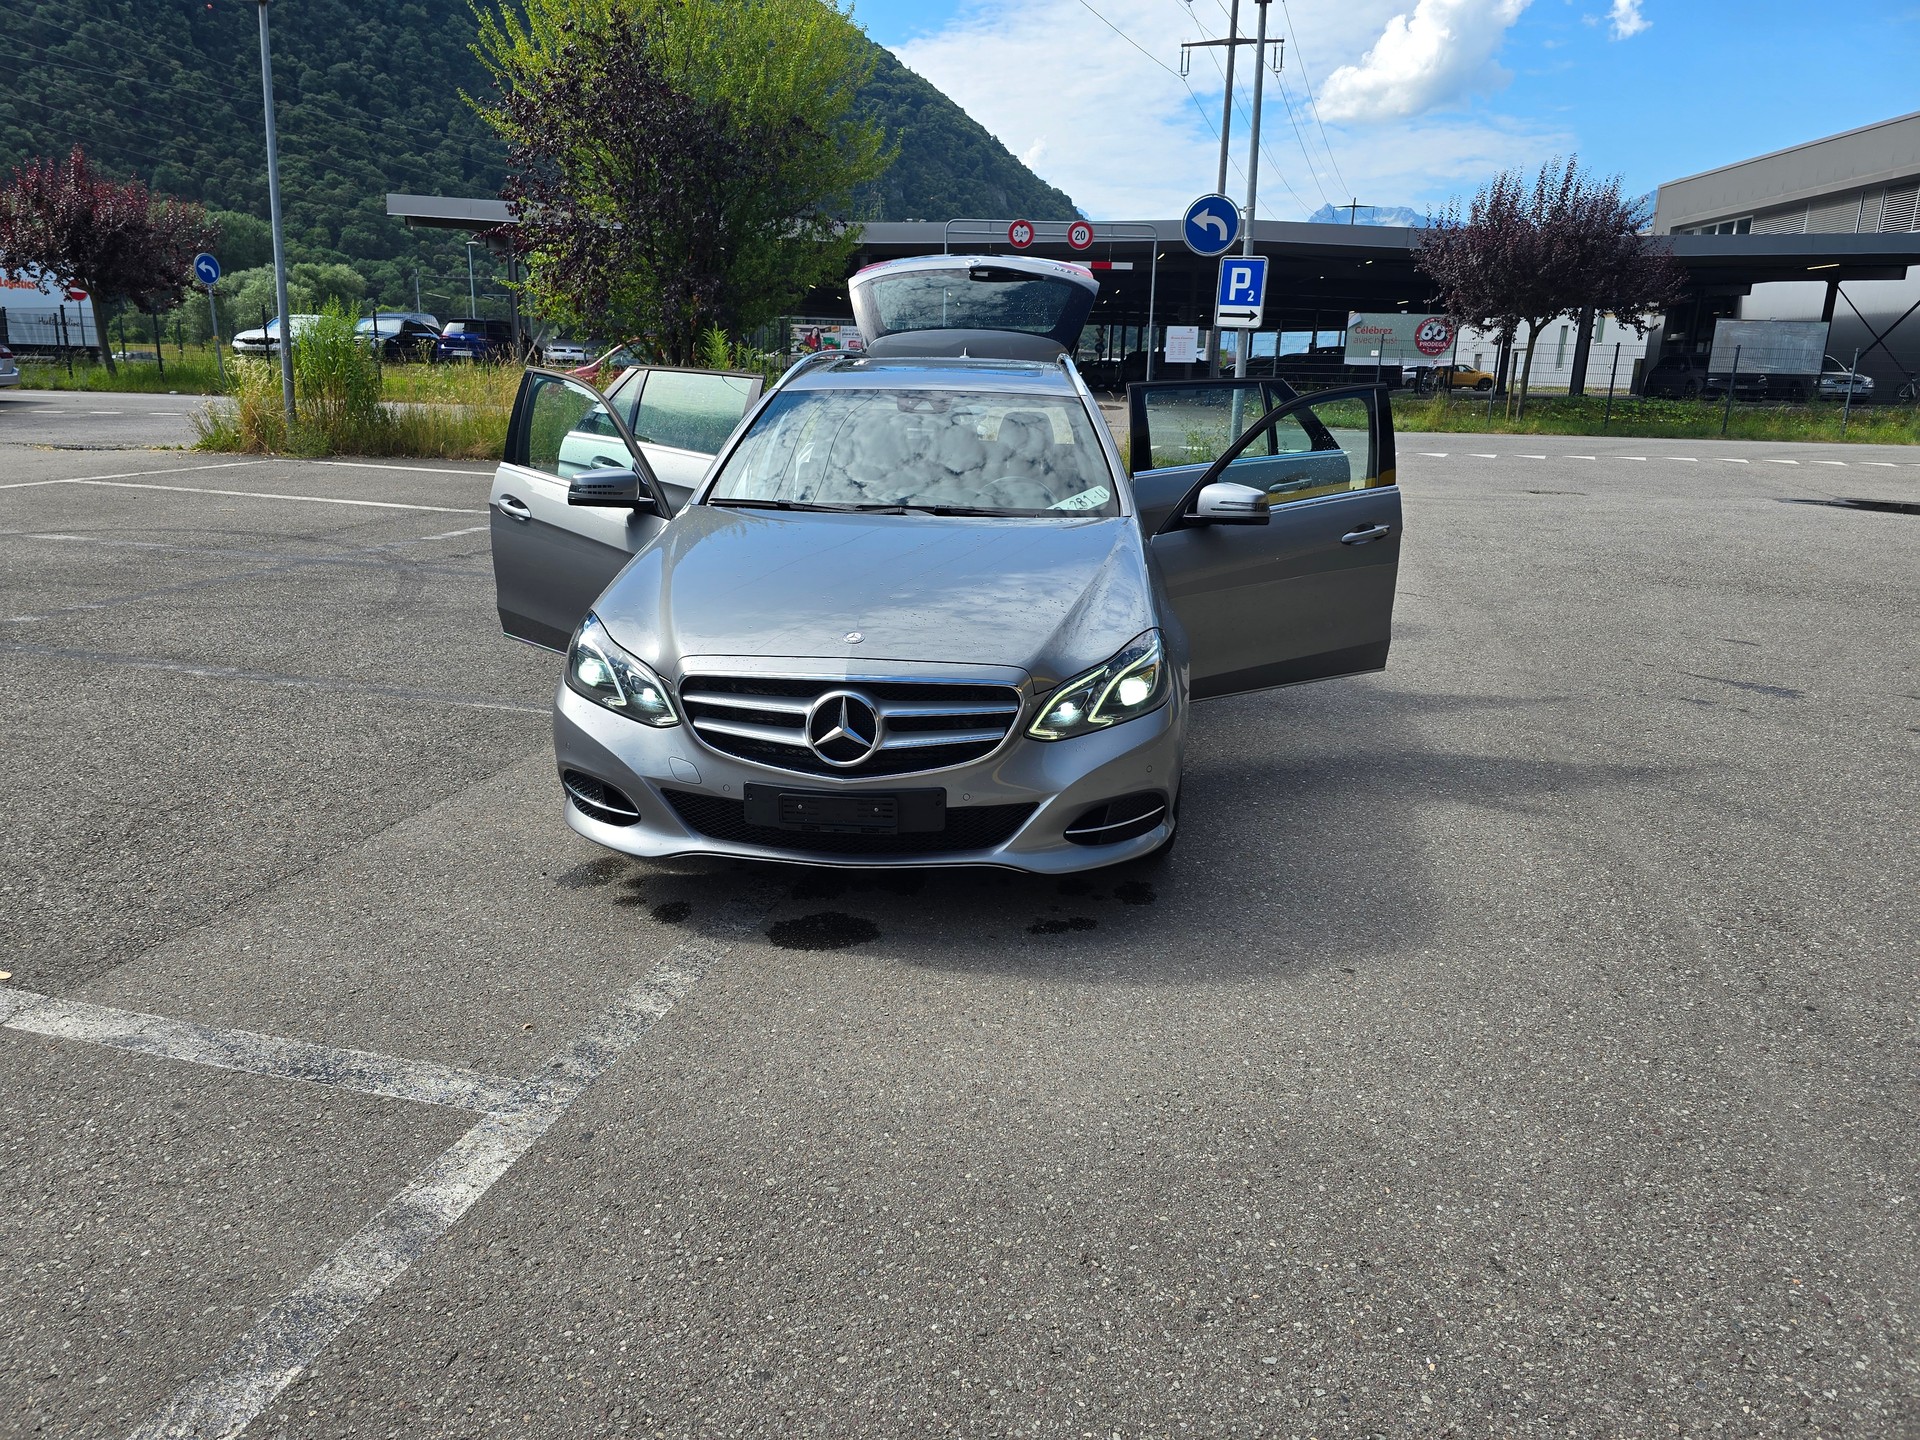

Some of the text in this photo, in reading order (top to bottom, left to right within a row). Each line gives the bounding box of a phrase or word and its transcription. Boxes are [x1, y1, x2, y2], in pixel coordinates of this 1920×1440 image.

[1075, 230, 1086, 240] 20
[1354, 325, 1393, 335] Célébrez
[1420, 325, 1446, 341] 60
[1353, 337, 1374, 345] avec
